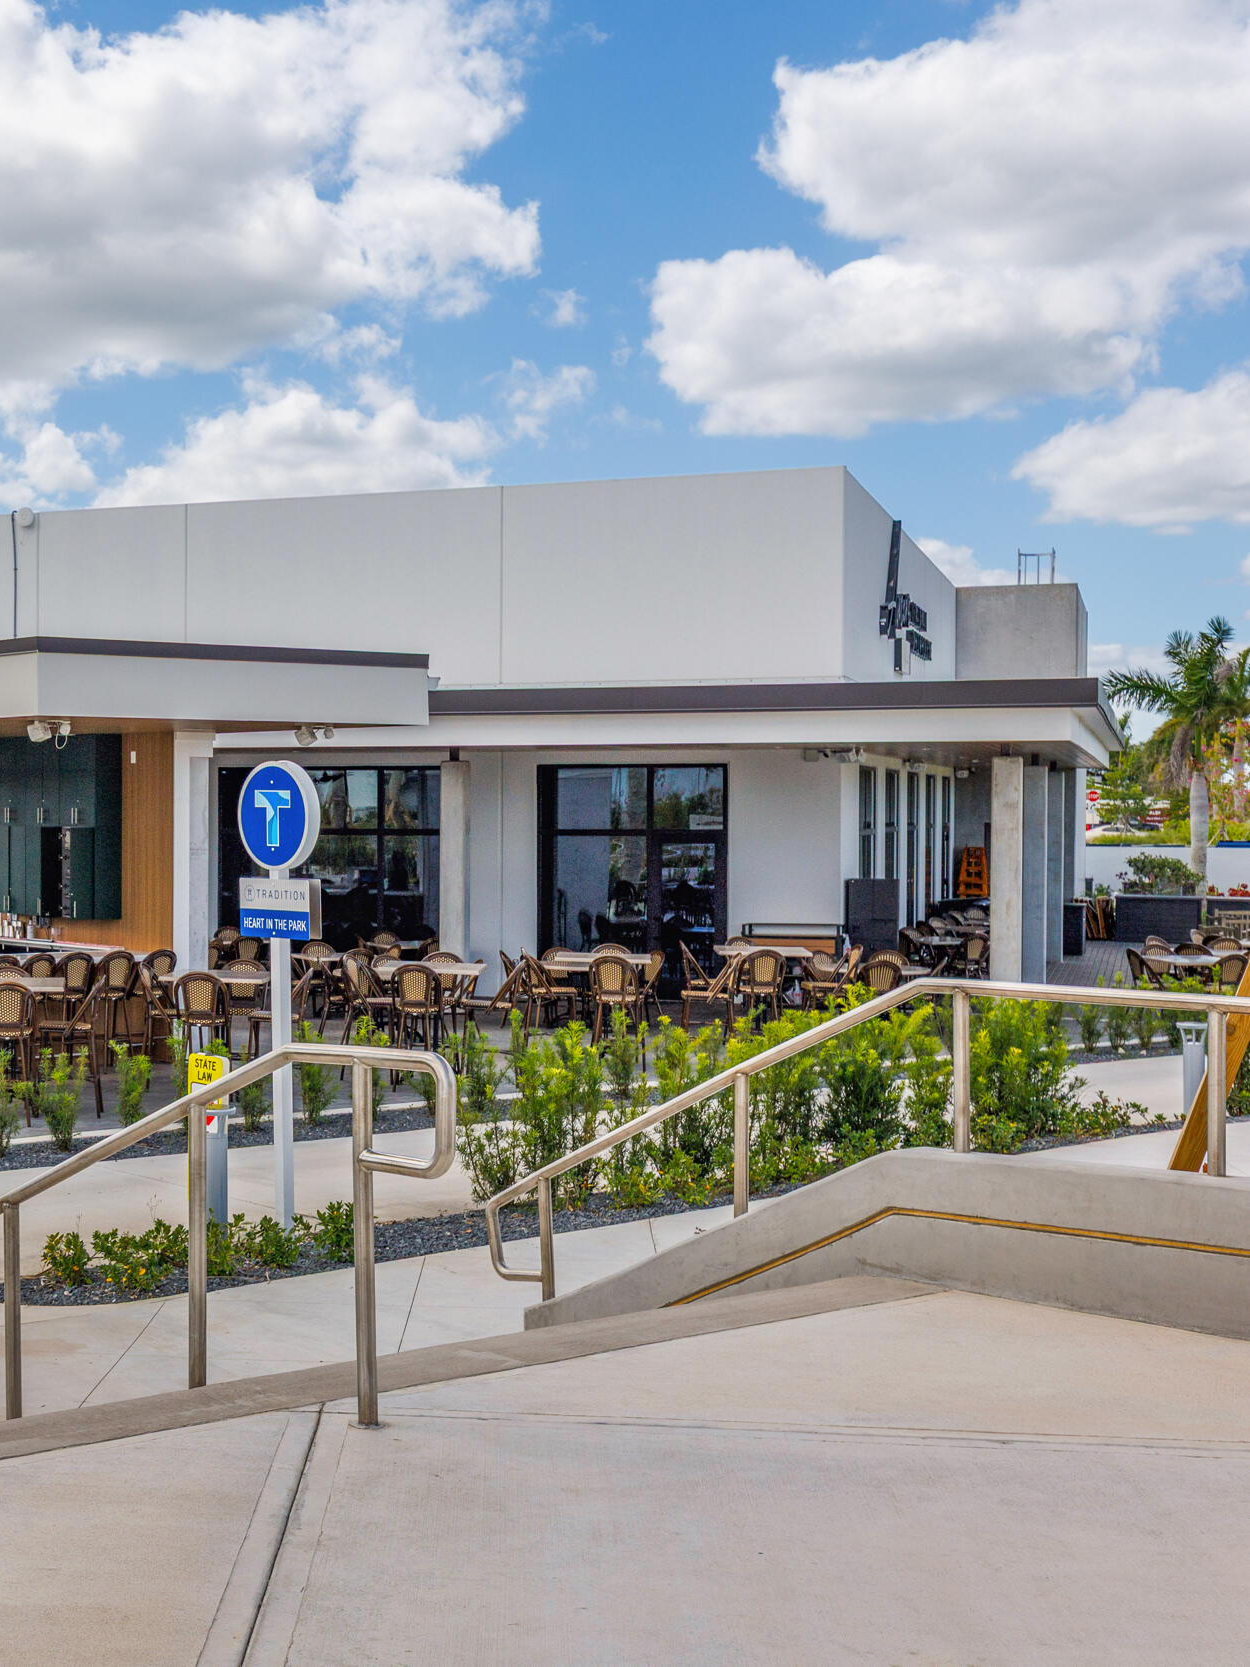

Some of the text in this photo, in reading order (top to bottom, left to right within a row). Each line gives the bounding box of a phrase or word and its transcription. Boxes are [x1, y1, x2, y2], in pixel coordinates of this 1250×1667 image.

[254, 790, 291, 846] T
[256, 888, 305, 901] TRADITION
[243, 917, 307, 932] HEART IN THE PARK
[195, 1058, 216, 1071] STATE
[198, 1071, 212, 1082] LAW
